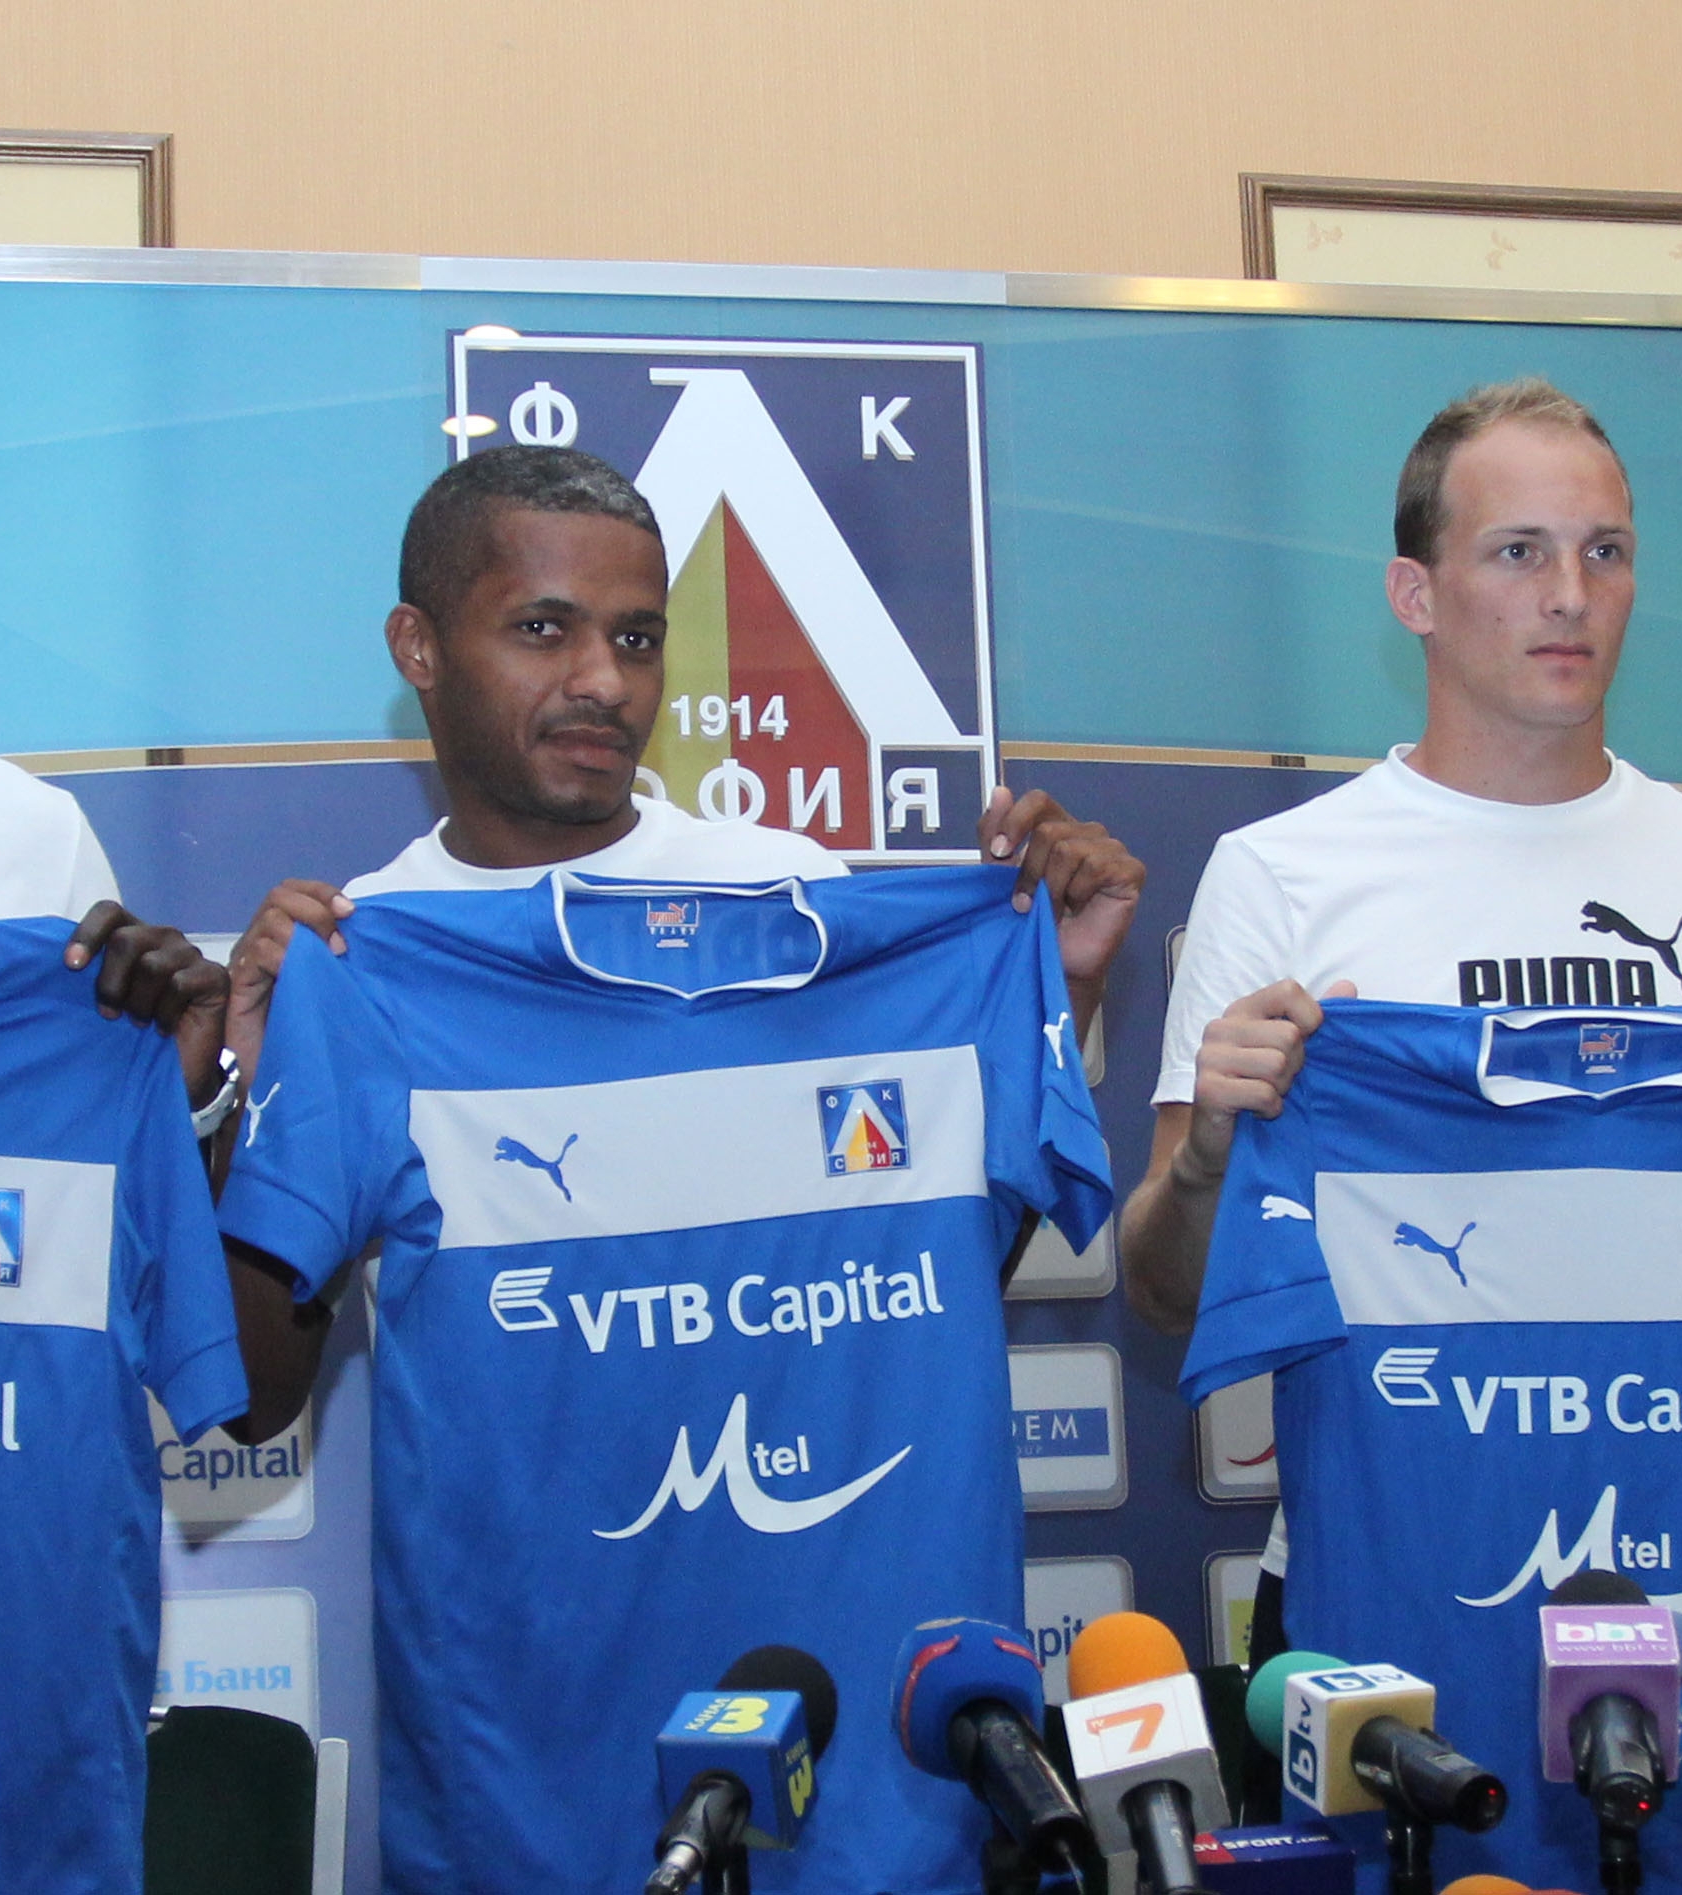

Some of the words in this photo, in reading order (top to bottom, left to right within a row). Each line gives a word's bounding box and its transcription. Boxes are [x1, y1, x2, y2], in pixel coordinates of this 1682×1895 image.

[508, 381, 578, 447] Ф
[671, 695, 789, 740] 1914
[635, 758, 941, 833] ФИЯ
[1458, 957, 1658, 1006] PUMA
[567, 1282, 714, 1353] VTB
[727, 1250, 944, 1346] Capital
[1451, 1376, 1591, 1434] VTB
[158, 1435, 303, 1490] Capital
[1554, 1622, 1669, 1643] bbt
[184, 1660, 293, 1694] Баня
[706, 1696, 770, 1735] 3
